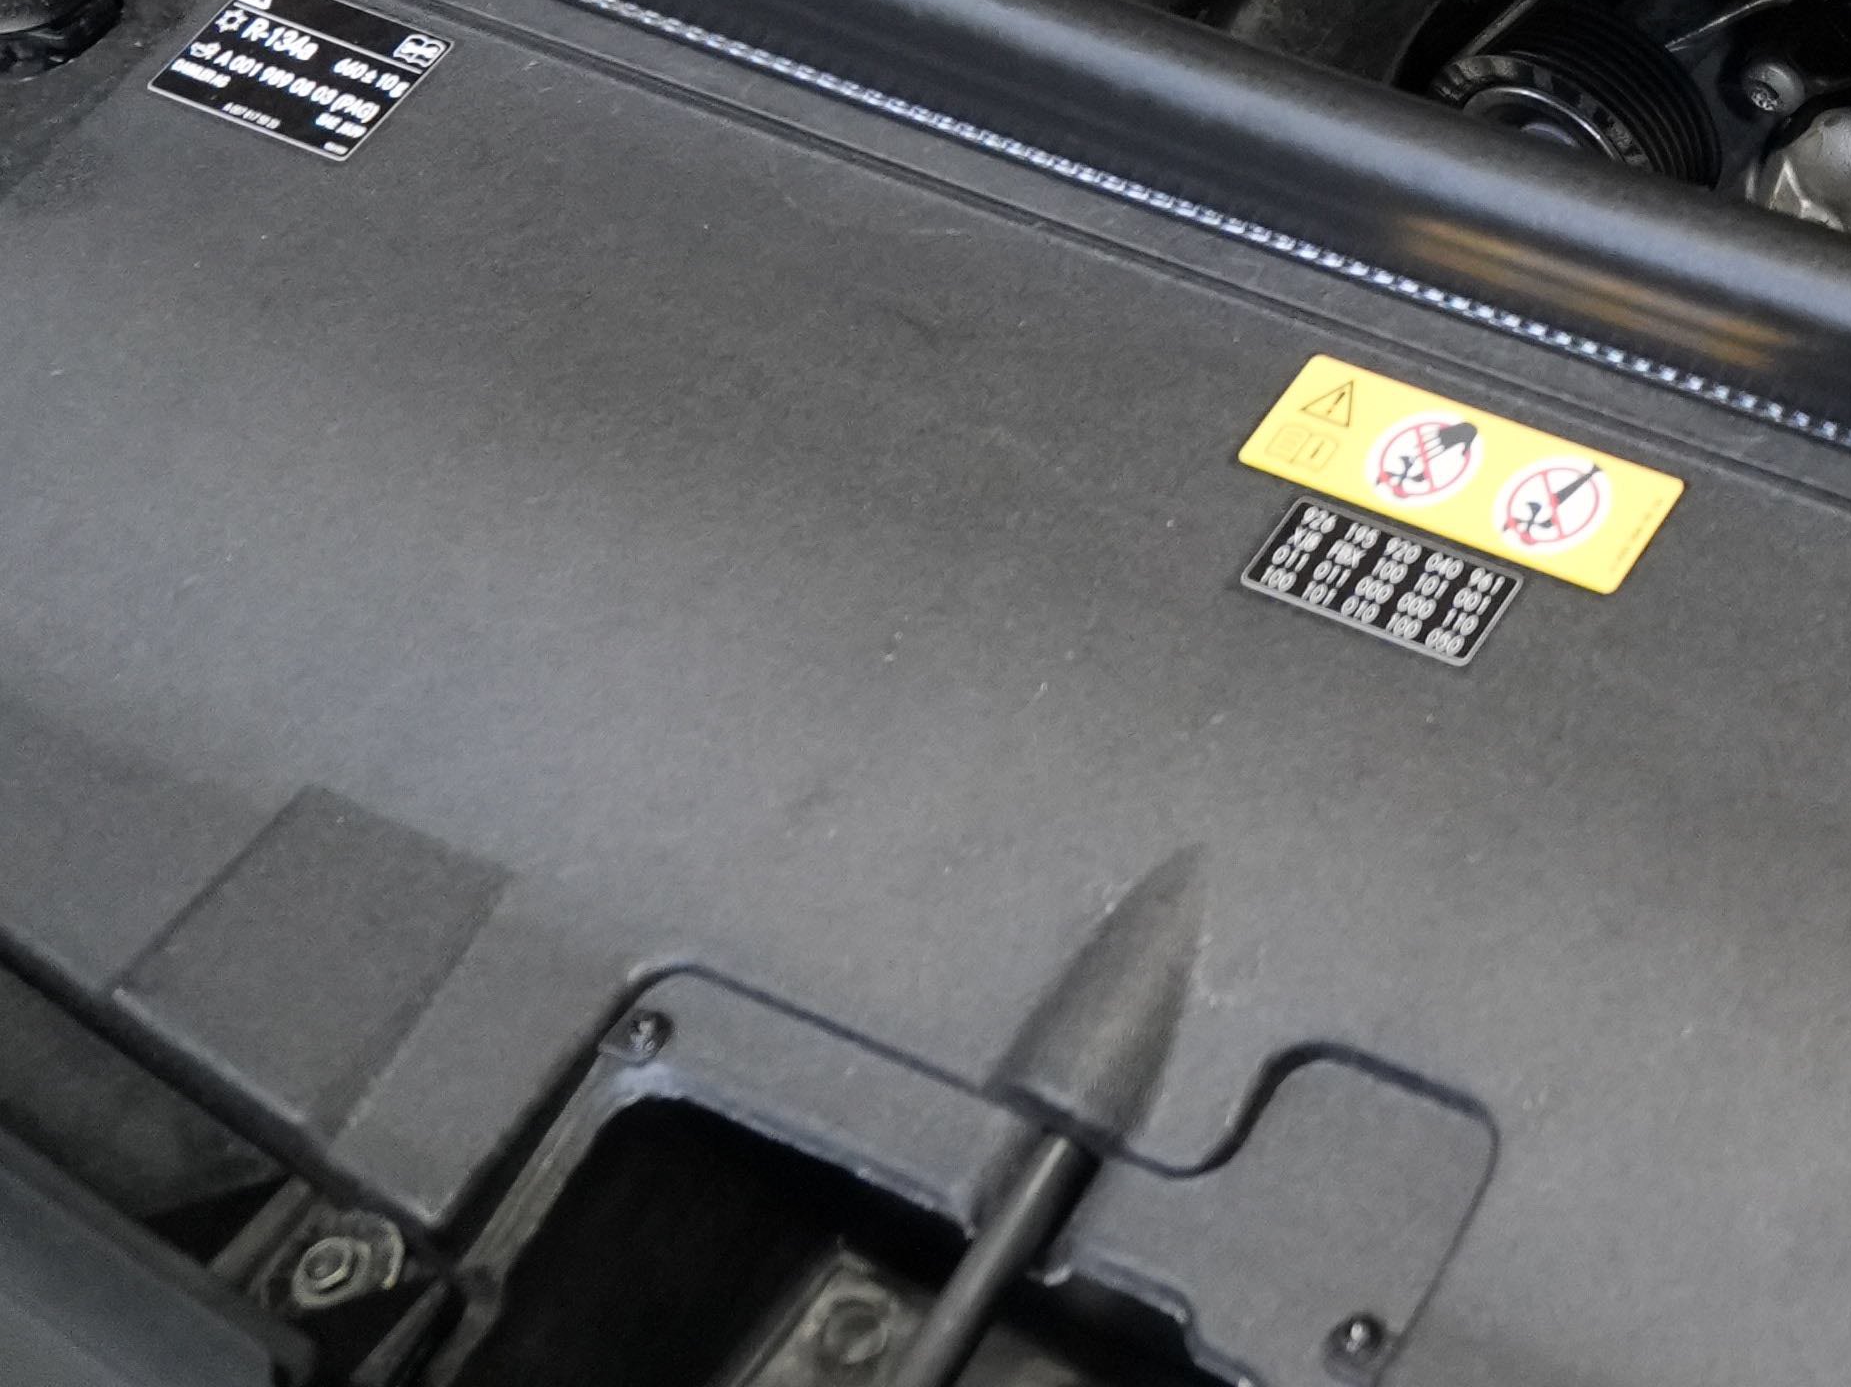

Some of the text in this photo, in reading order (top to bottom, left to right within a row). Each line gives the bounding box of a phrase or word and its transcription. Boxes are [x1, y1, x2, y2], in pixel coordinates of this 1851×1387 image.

[213, 50, 233, 66] A
[228, 54, 263, 77] 001
[258, 66, 294, 88] 989
[329, 93, 379, 123] (PAG)
[241, 17, 318, 60] R-134a
[333, 58, 368, 79] 660
[375, 72, 399, 90] 10
[1300, 506, 1337, 533] 926
[1383, 536, 1421, 564] 920
[1467, 567, 1505, 595] 961
[1369, 556, 1408, 584] 100
[1412, 571, 1449, 599] 101
[1452, 586, 1491, 616] 001
[1258, 564, 1296, 592] 100
[1300, 580, 1337, 607] 101
[1336, 594, 1380, 625] 010
[1382, 611, 1422, 641] 100
[1271, 544, 1309, 572] 011
[1312, 559, 1351, 587] 011
[1354, 575, 1394, 604] 000
[1396, 591, 1436, 620] 000
[1440, 607, 1478, 636] 110
